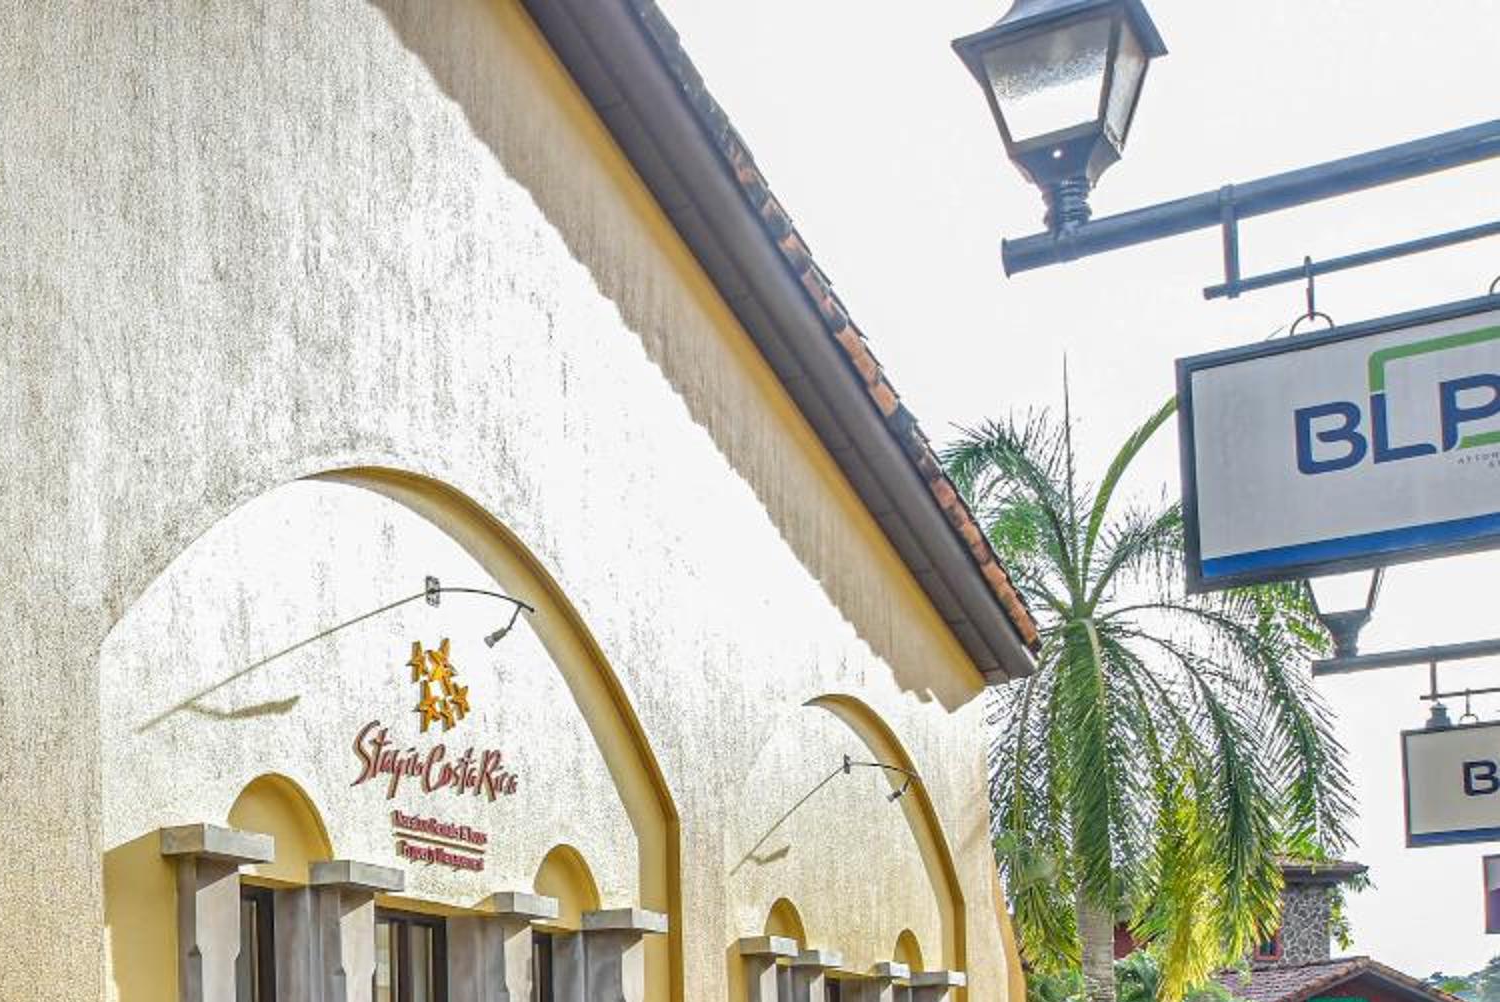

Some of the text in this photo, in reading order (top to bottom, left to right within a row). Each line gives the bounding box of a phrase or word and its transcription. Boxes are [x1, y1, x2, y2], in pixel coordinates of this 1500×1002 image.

[1294, 374, 1500, 475] BLP
[350, 720, 401, 800] Stay
[421, 744, 476, 795] Costa
[473, 750, 518, 802] Rica
